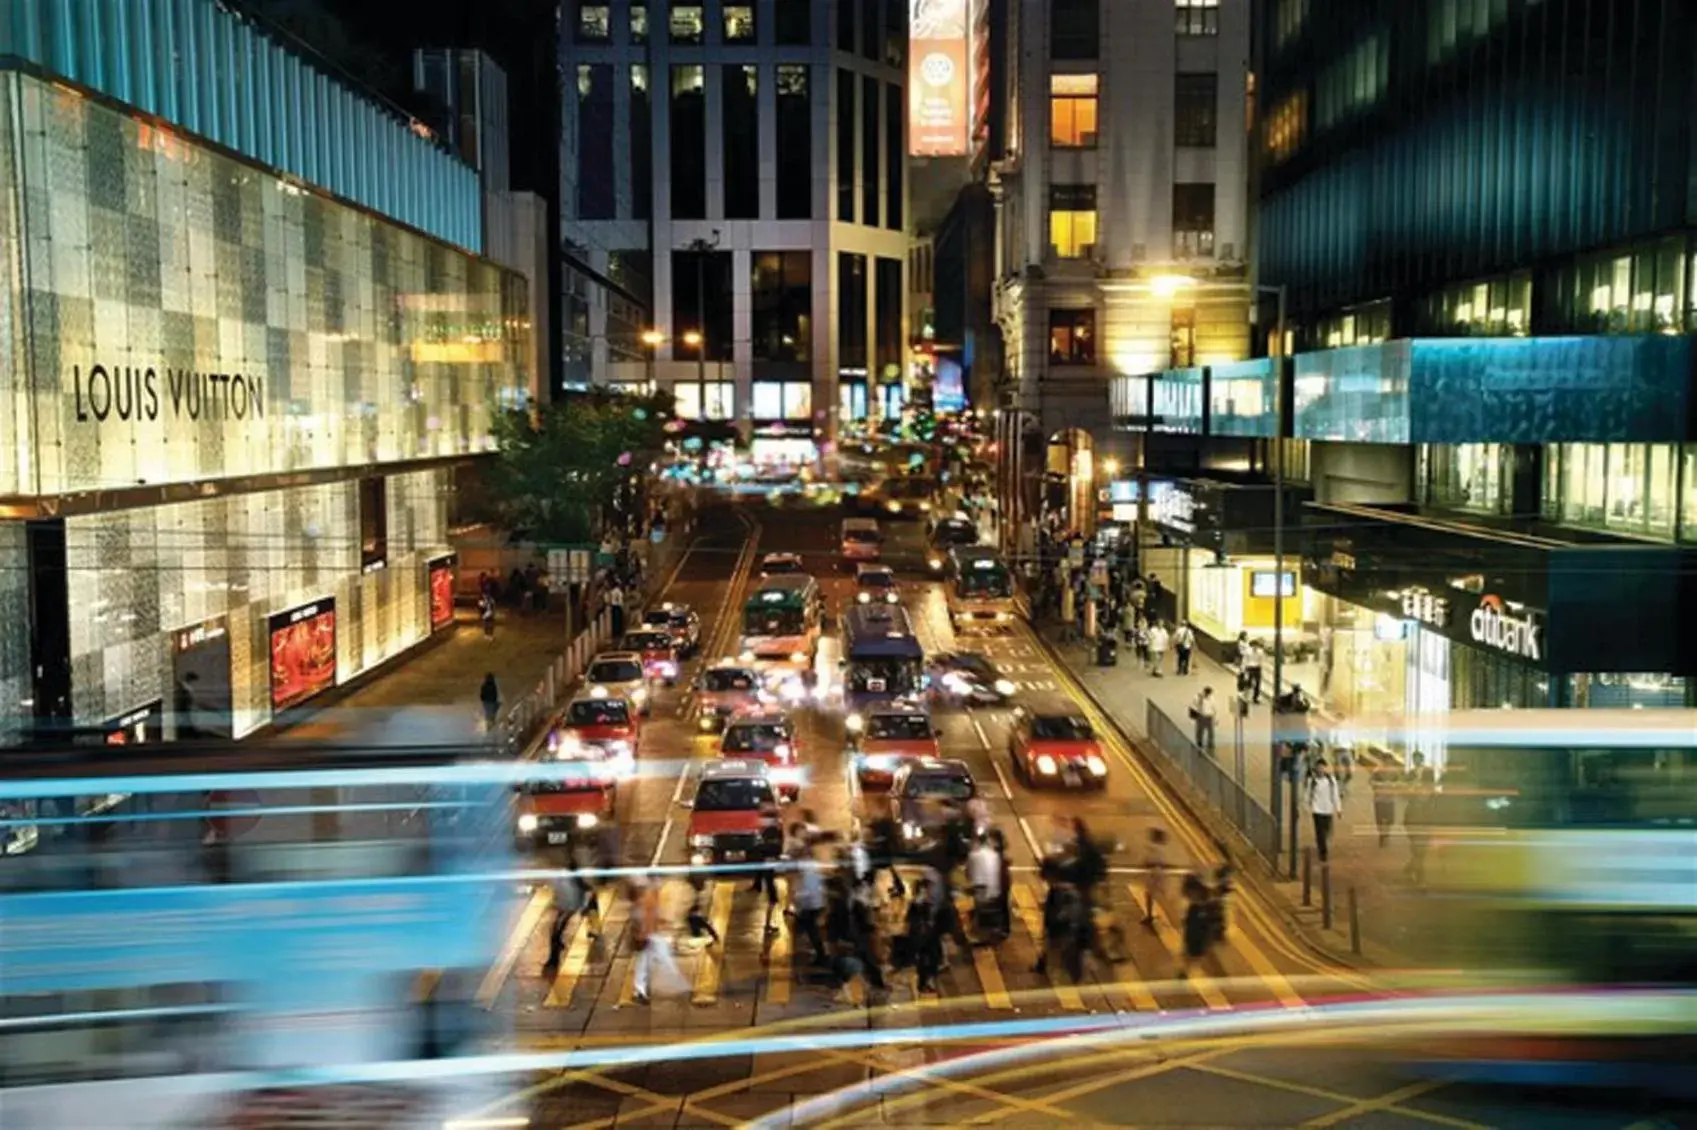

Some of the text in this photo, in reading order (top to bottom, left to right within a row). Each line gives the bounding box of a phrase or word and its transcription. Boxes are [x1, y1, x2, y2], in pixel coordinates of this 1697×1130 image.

[74, 365, 264, 422] LOUIS VUITTON
[1471, 604, 1540, 660] citibank
